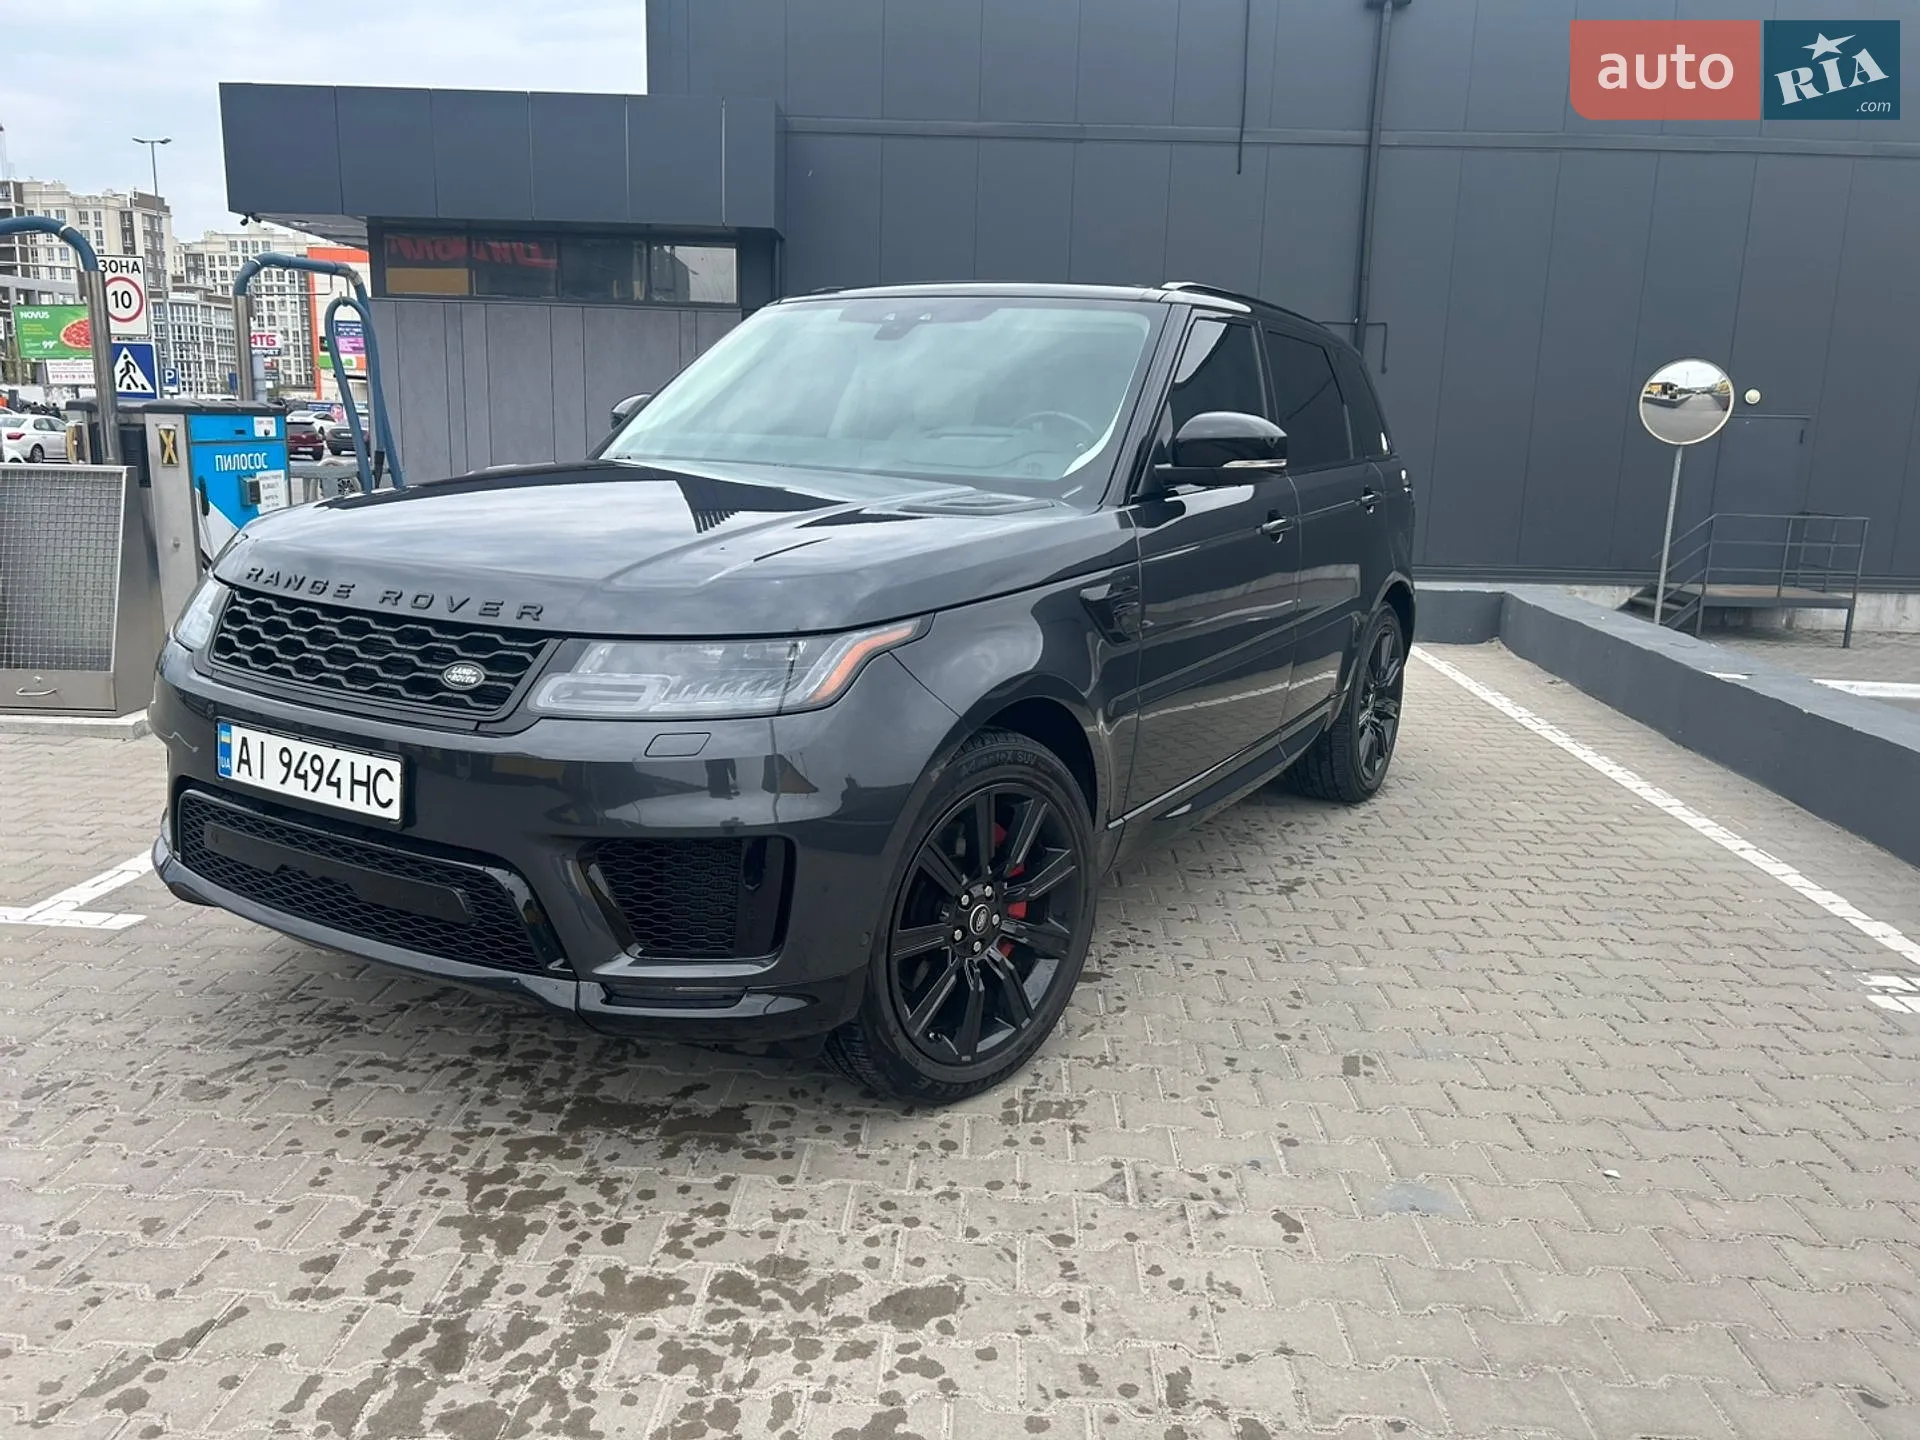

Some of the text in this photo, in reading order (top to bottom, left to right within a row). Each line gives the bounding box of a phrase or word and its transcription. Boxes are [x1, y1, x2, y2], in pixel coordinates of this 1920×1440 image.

[98, 259, 142, 275] ЗОНА
[111, 290, 132, 309] 10
[20, 310, 50, 320] NOVUS
[165, 369, 176, 384] P
[214, 452, 269, 473] ПИЛОСОС
[246, 566, 545, 621] RANGE ROVER
[220, 756, 232, 770] UA
[236, 736, 395, 809] AI 9494 HC
